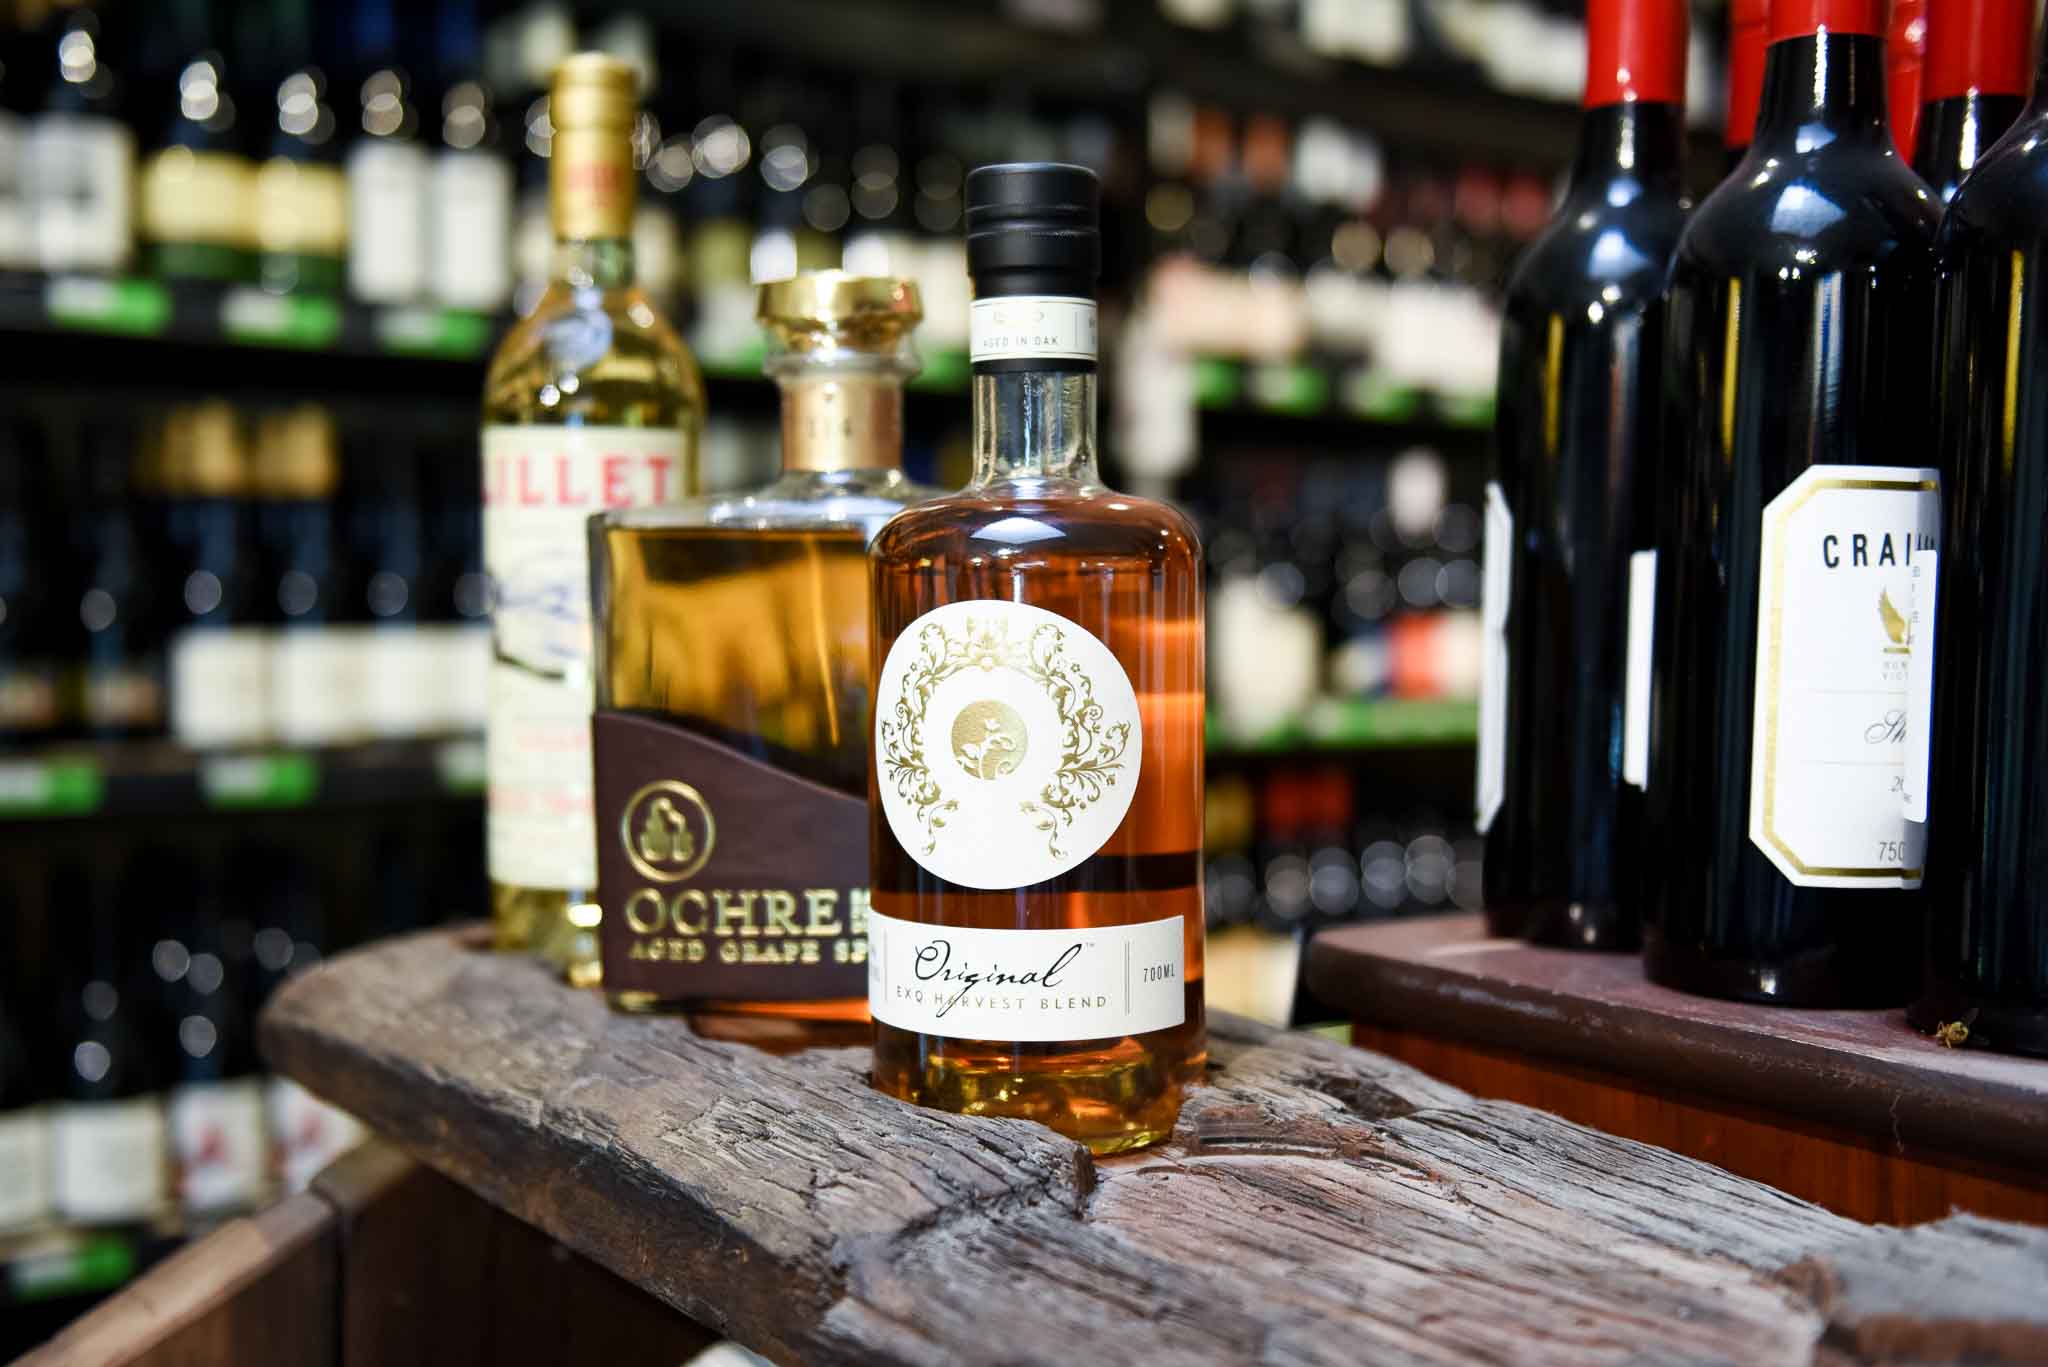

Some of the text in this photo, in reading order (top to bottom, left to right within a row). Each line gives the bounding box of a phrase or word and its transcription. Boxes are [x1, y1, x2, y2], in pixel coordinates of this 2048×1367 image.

[1015, 336, 1028, 345] IN
[1034, 336, 1058, 345] OAK
[482, 455, 673, 507] ILLET
[1823, 532, 1911, 568] CRAI
[1879, 841, 1905, 863] 750
[625, 887, 842, 937] OCHRE
[915, 939, 1082, 1017] Original
[1143, 964, 1176, 983] 700ML
[897, 984, 1107, 1010] EXQ HARVEST BLEND
